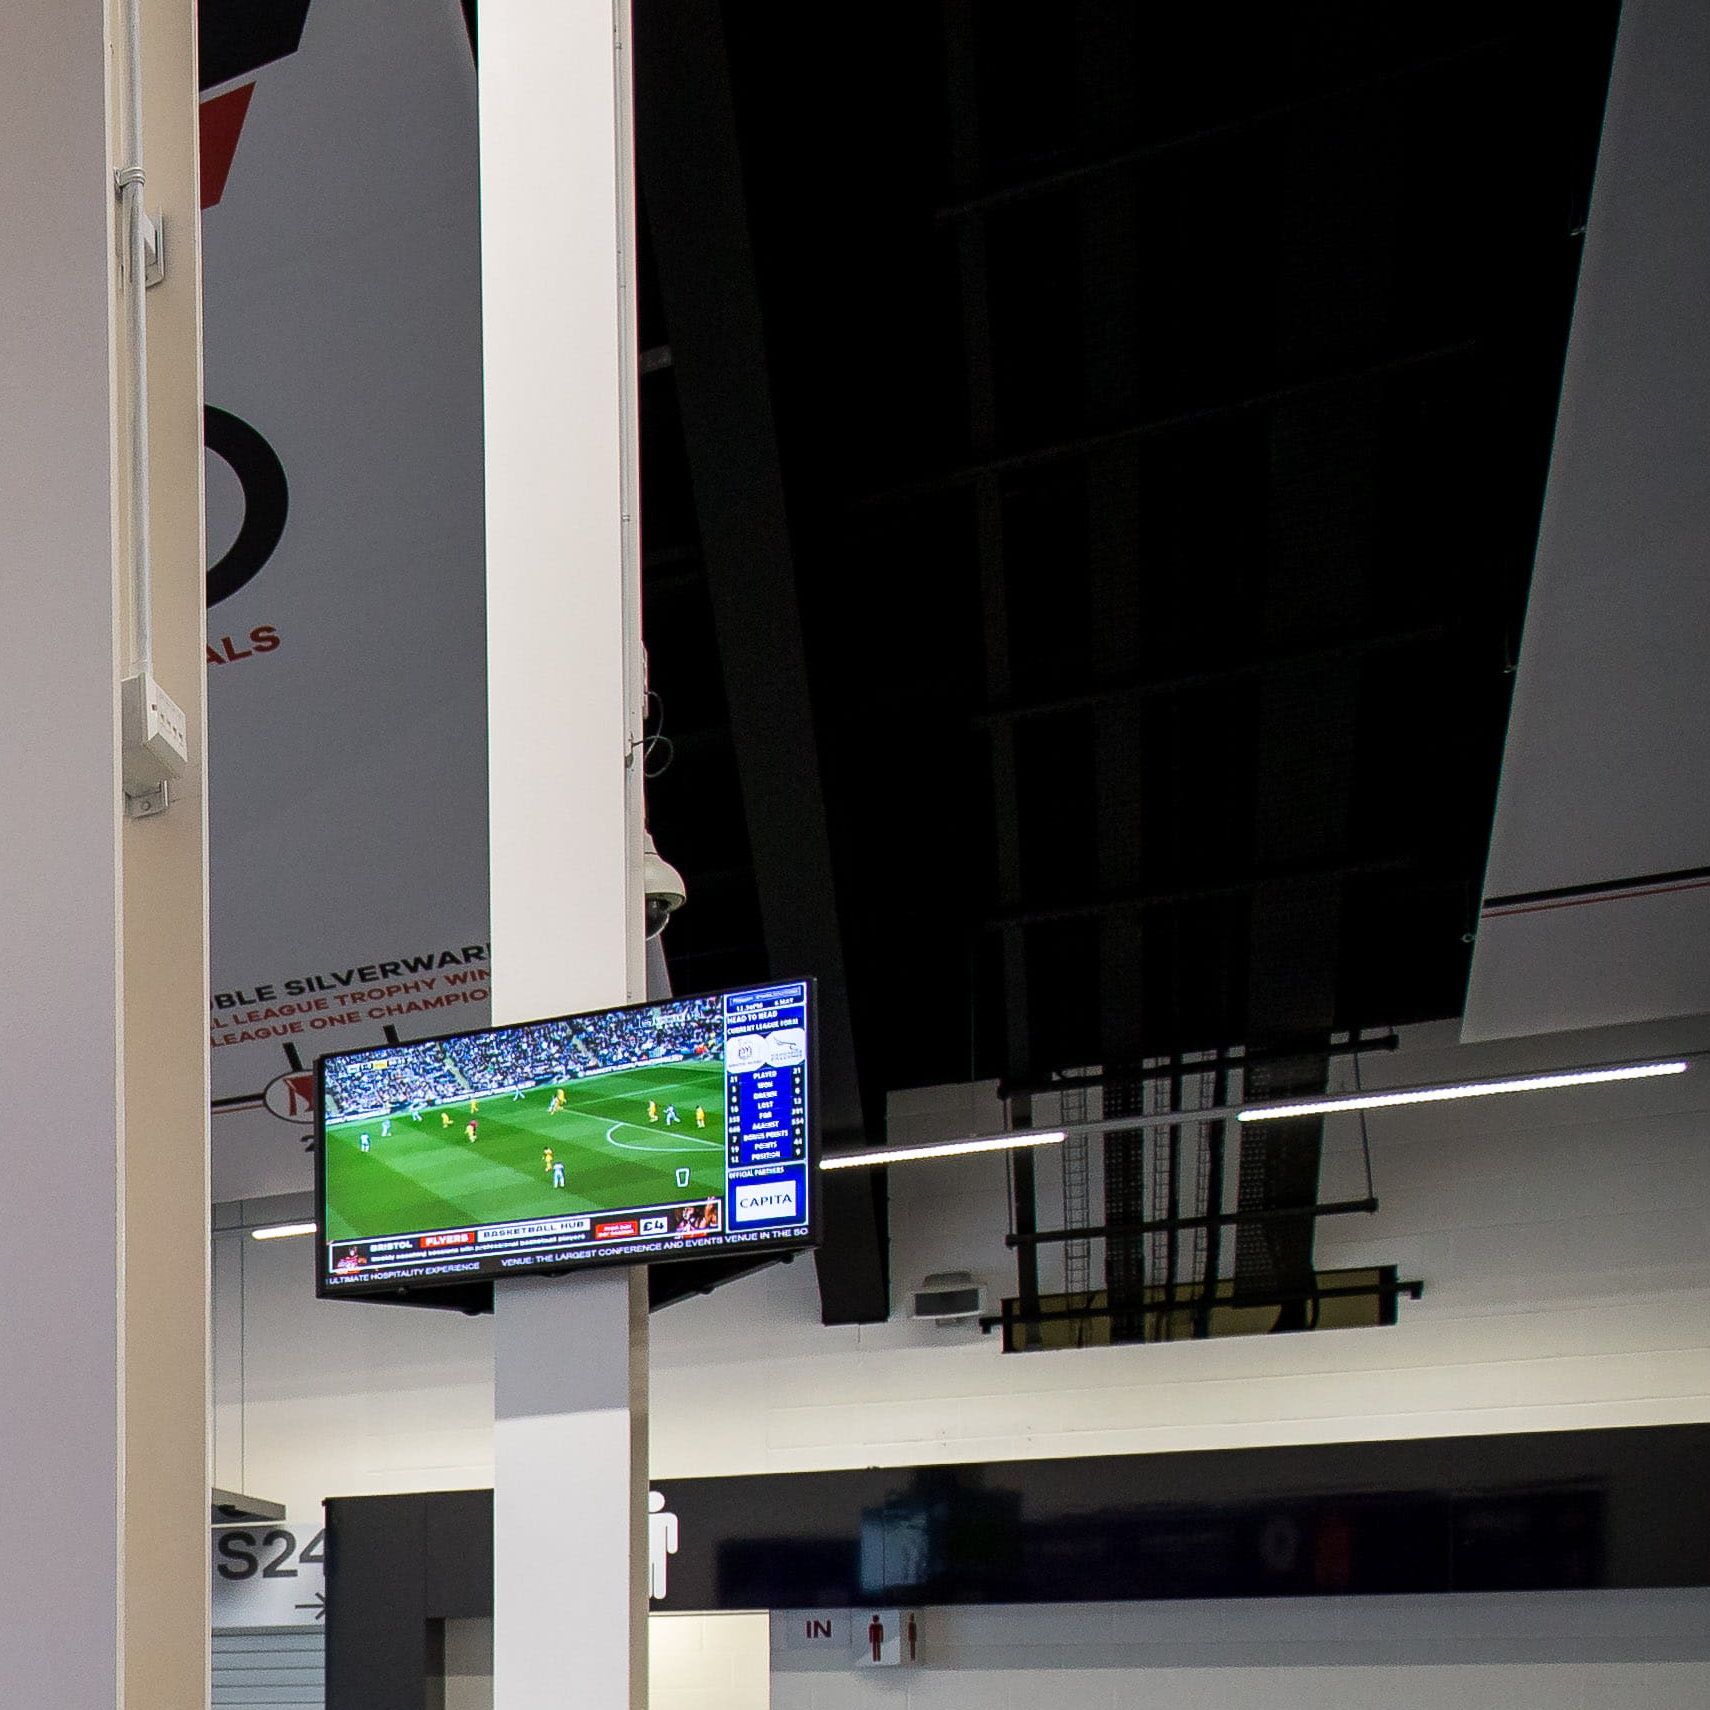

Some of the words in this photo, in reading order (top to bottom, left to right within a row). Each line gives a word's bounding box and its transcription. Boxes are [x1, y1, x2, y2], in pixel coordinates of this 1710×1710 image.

[284, 943, 491, 997] SILVERWAR
[233, 998, 329, 1025] LEAGUE
[334, 978, 437, 1006] TROPHY
[309, 1009, 362, 1030] ONE
[740, 1193, 792, 1208] CAPITA
[369, 1240, 413, 1252] BRISTOL
[425, 1233, 469, 1246] FLYERS
[483, 1223, 557, 1238] BASKETBALL
[560, 1220, 585, 1230] HUB
[643, 1221, 665, 1232] £4
[501, 1256, 535, 1267] VENUE:
[536, 1253, 553, 1263] THE
[555, 1248, 597, 1262] LARGEST
[598, 1242, 662, 1257] CONFERENCE
[663, 1241, 684, 1250] AND
[685, 1237, 723, 1248] EVENTS
[725, 1232, 758, 1243] VENUE
[760, 1231, 770, 1240] IN
[772, 1229, 792, 1239] THE
[329, 1272, 370, 1285] ULTIMATE
[370, 1268, 425, 1281] HOSPITALITY
[425, 1261, 480, 1275] EXPERIENCE
[217, 1528, 326, 1581] S24
[805, 1620, 833, 1640] IN
